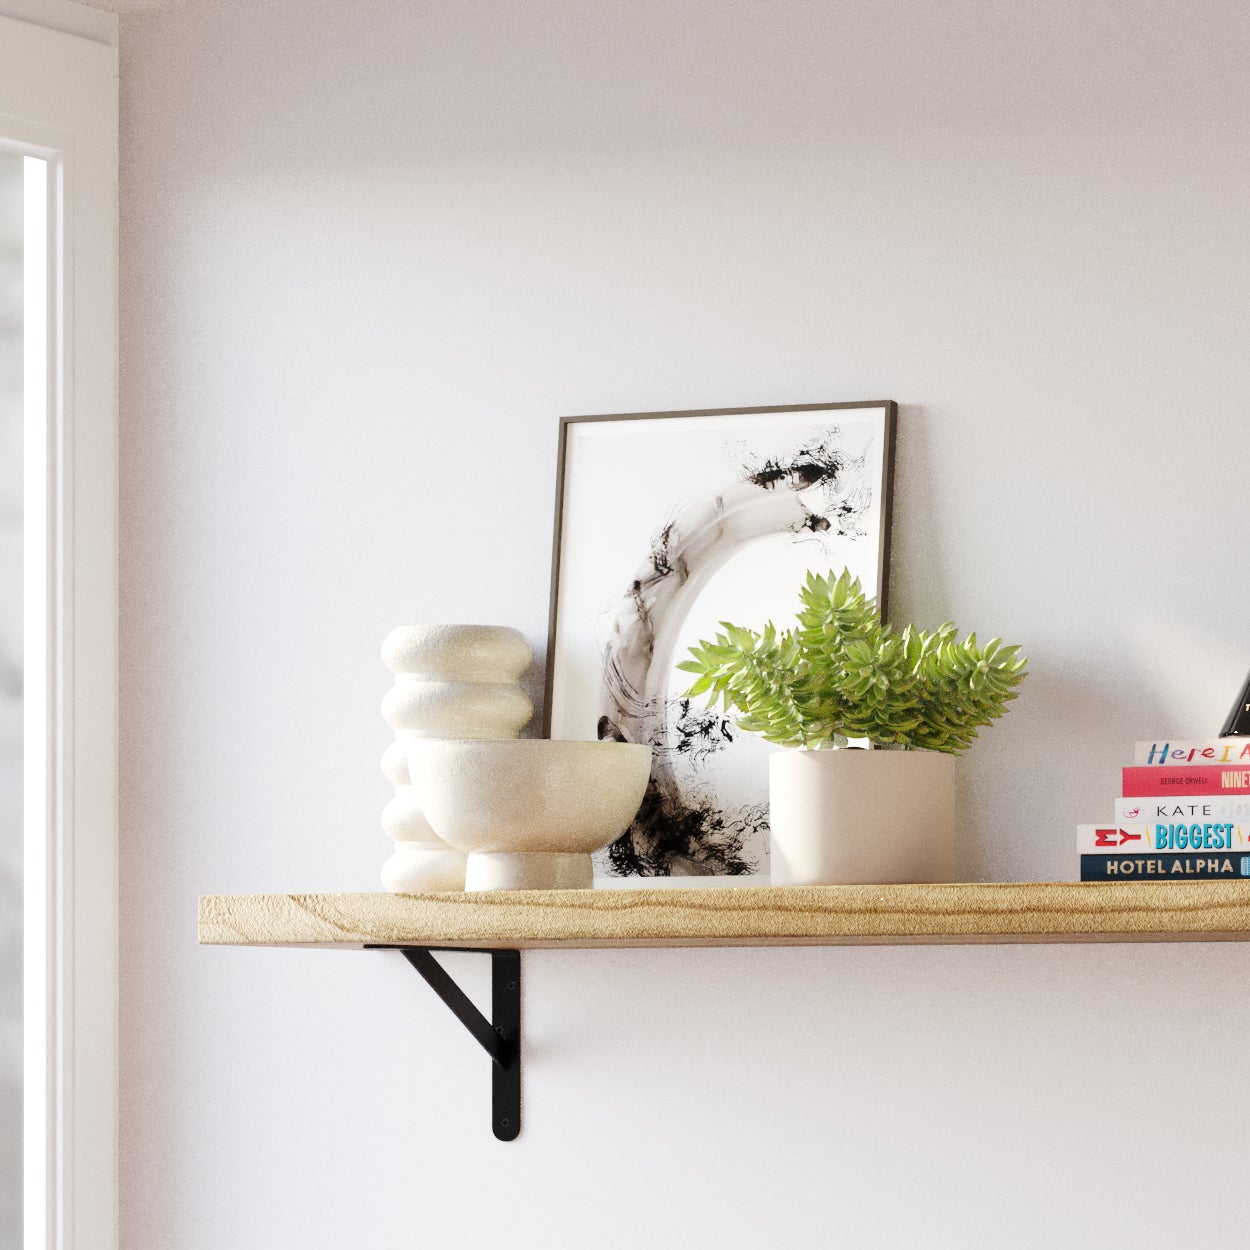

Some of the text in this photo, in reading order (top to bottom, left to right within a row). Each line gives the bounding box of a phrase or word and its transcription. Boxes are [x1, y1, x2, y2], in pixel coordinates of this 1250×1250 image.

[1147, 743, 1215, 765] Here
[1215, 745, 1237, 763] I
[1160, 776, 1208, 785] GEORGE ORWELL
[1156, 804, 1212, 816] KATE
[1095, 828, 1142, 847] MY
[1155, 823, 1234, 849] BIGGEST
[1106, 858, 1234, 875] HOTEL ALPHA
